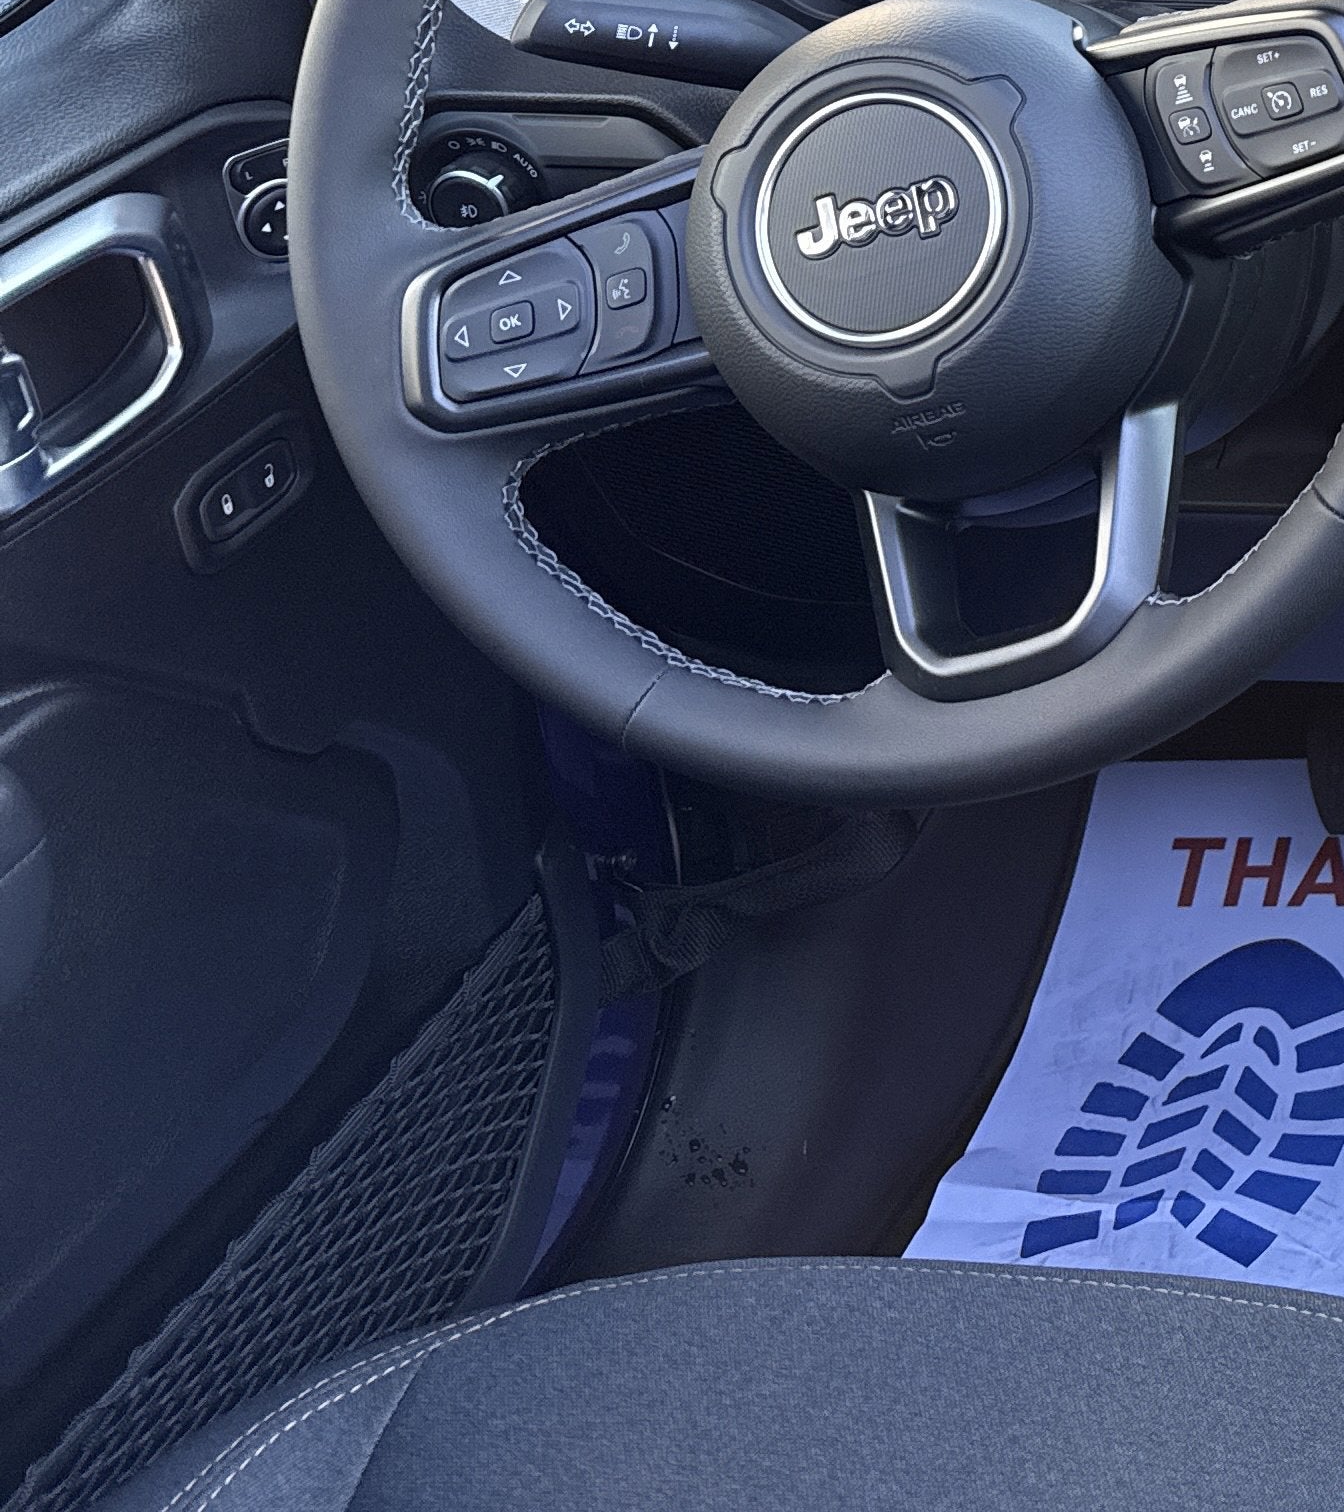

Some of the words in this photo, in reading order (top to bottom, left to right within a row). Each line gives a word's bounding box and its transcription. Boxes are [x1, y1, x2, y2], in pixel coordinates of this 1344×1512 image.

[1256, 50, 1281, 65] SET+
[1309, 84, 1329, 99] RES
[1230, 103, 1259, 120] CANC
[513, 152, 538, 178] AUTO
[245, 170, 253, 181] L
[796, 176, 960, 258] Jeep
[499, 312, 522, 331] OK
